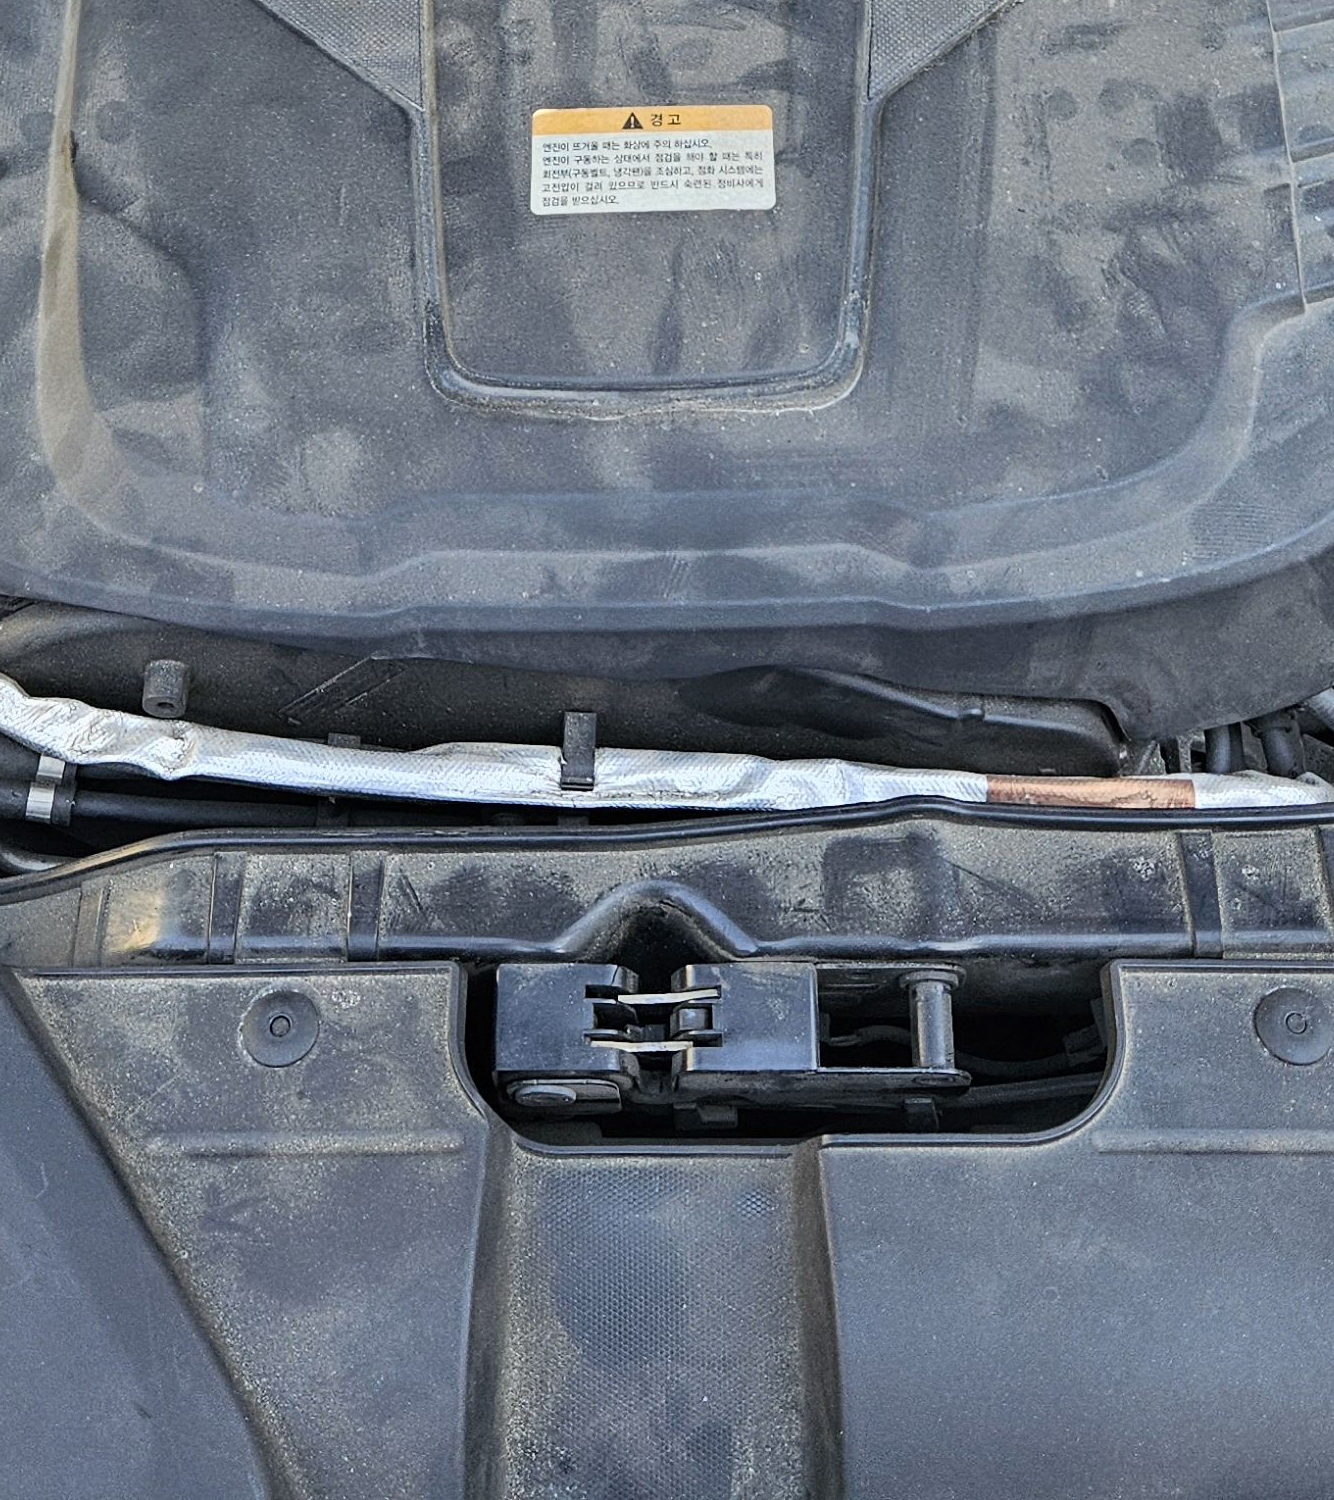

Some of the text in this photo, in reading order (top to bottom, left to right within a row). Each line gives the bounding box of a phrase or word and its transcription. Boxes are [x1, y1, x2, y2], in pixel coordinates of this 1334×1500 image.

[543, 139, 713, 153] 엔진이 뜨거울 때는 화상에 주의 하십시오.
[542, 195, 621, 207] 점검을 받으십시오.
